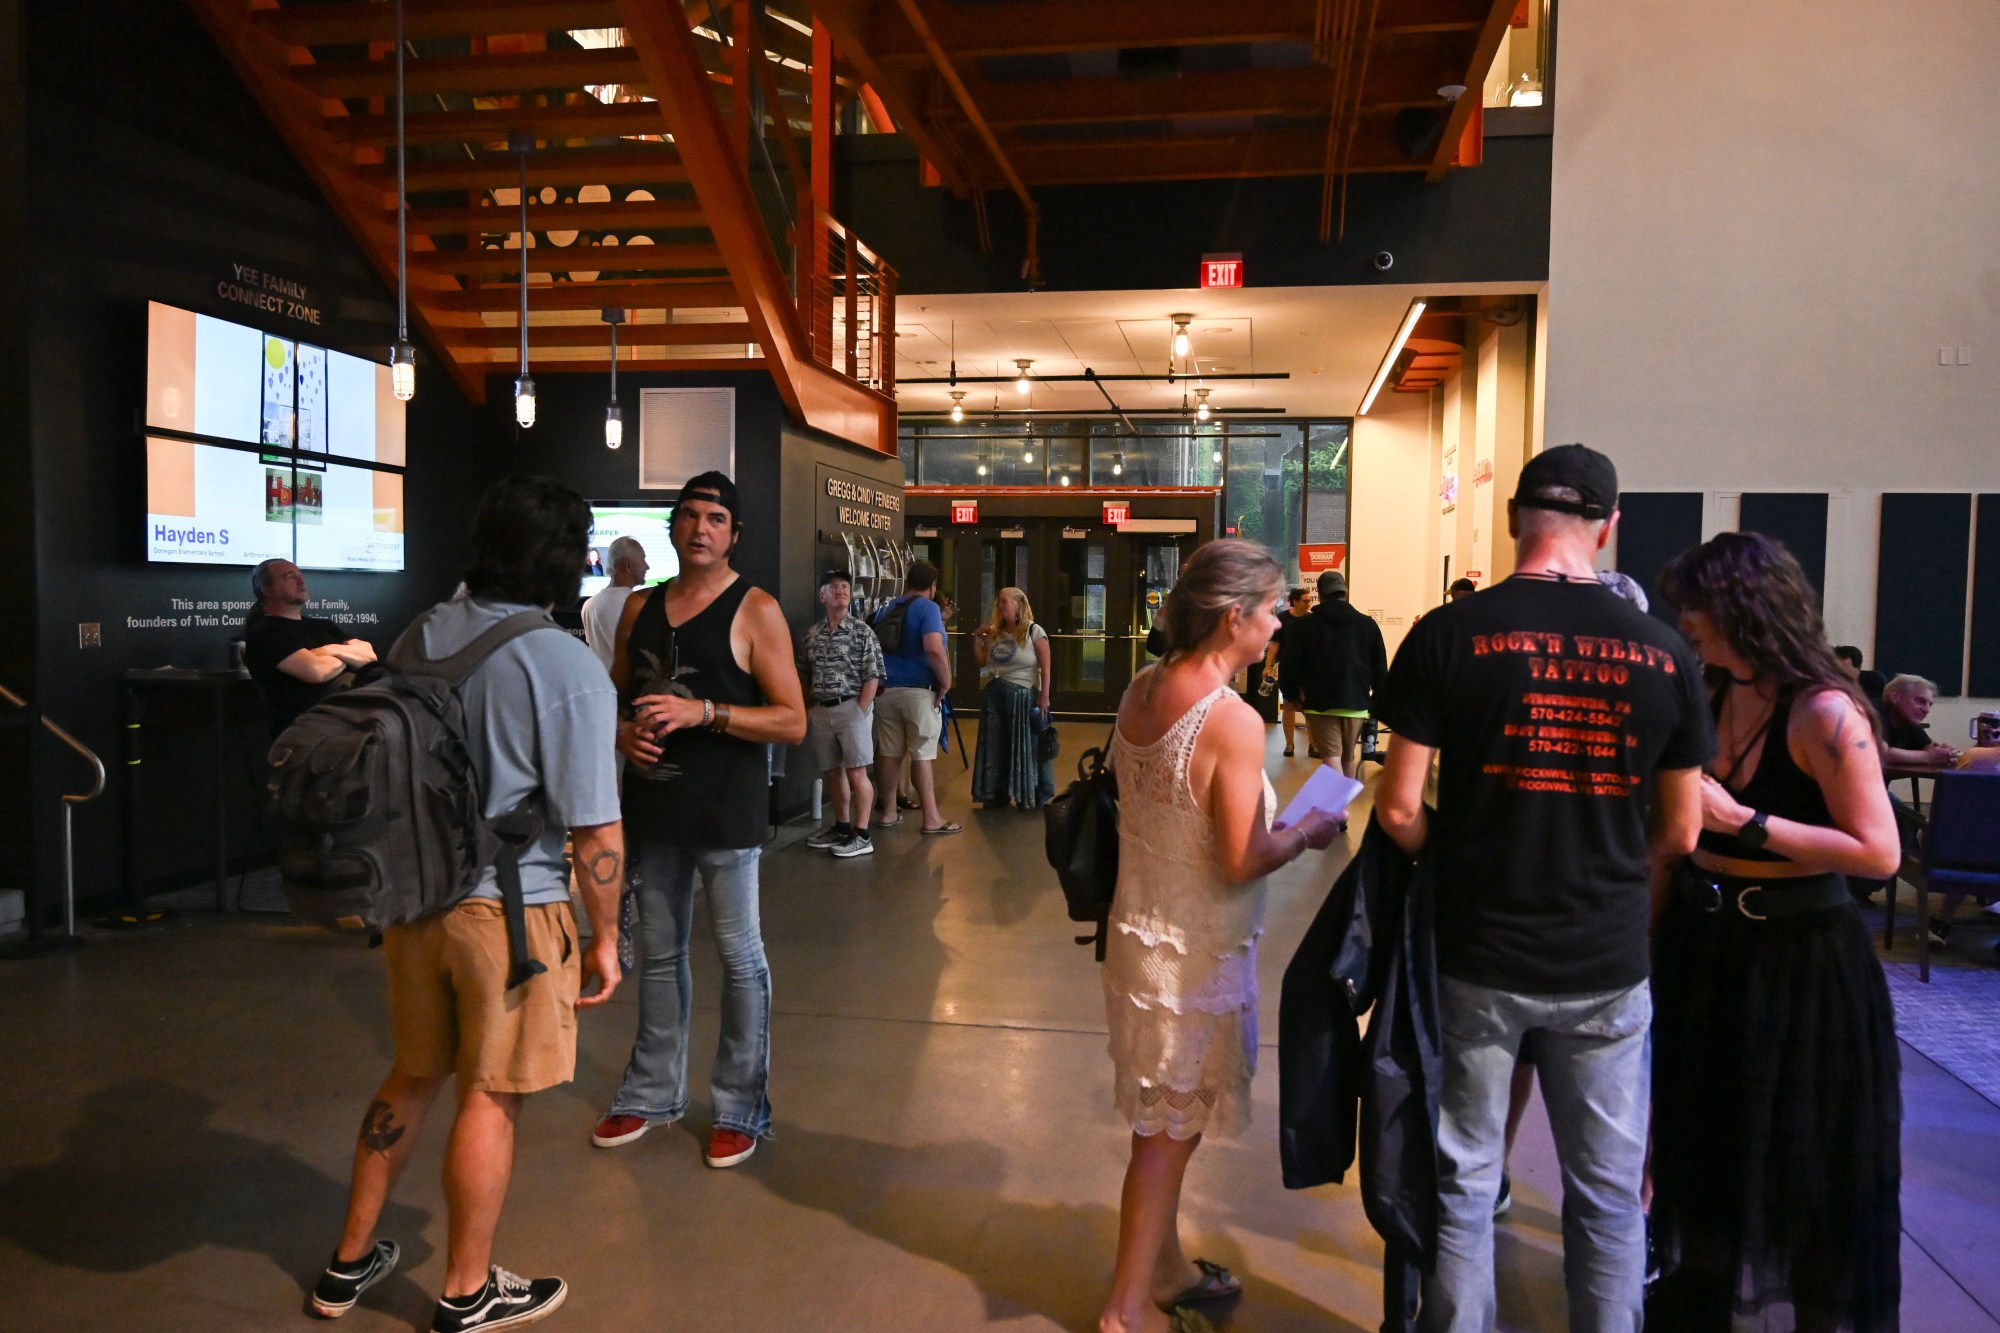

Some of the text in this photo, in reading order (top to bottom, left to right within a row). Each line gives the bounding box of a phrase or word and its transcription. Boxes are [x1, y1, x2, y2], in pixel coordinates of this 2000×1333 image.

[233, 263, 307, 300] YEE FAMILY
[1208, 264, 1237, 286] EXIT
[218, 281, 321, 325] CONNECT ZONE
[827, 478, 900, 512] GREGG & CINDY FEINBERG
[839, 506, 891, 531] WELCOME CENTER
[956, 507, 974, 522] EXIT
[1107, 507, 1126, 523] EXIT
[154, 524, 230, 547] Hayden S
[178, 548, 208, 557] Elementary
[171, 598, 350, 612] This area spons Yee Family,
[127, 616, 178, 628] founders
[180, 616, 192, 627] of
[194, 615, 220, 627] Twin
[331, 613, 380, 624] (1962-1994).
[1472, 631, 1676, 675] ROCK'N WILLY'S
[1528, 657, 1629, 685] TATTOO
[1530, 707, 1622, 727] 570-424-5542
